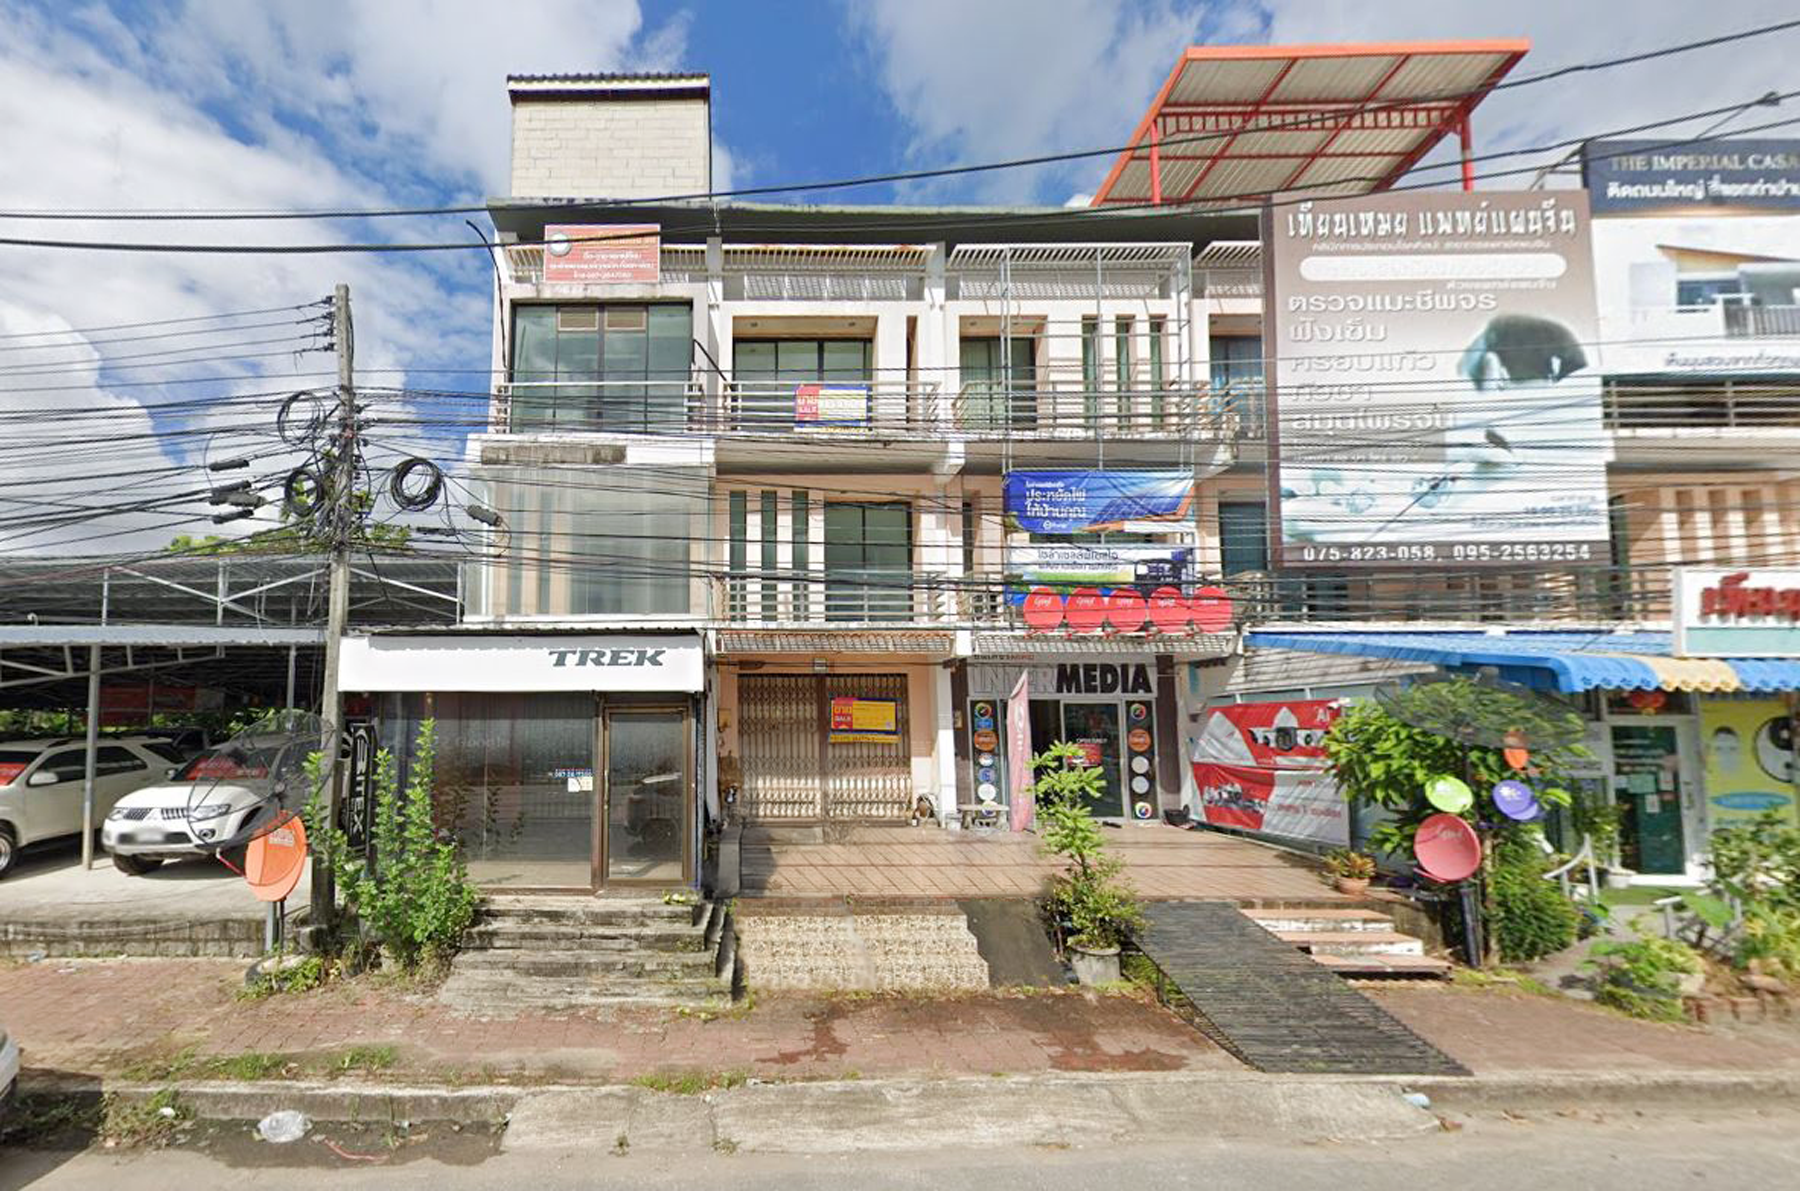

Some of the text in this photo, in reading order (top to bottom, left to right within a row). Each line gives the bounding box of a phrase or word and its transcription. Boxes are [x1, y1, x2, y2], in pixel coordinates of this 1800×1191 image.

[1611, 156, 1649, 171] THE
[1652, 155, 1745, 171] IMPERIAL
[1418, 197, 1577, 235] แพทย์แผนจีน
[548, 649, 666, 667] TREK
